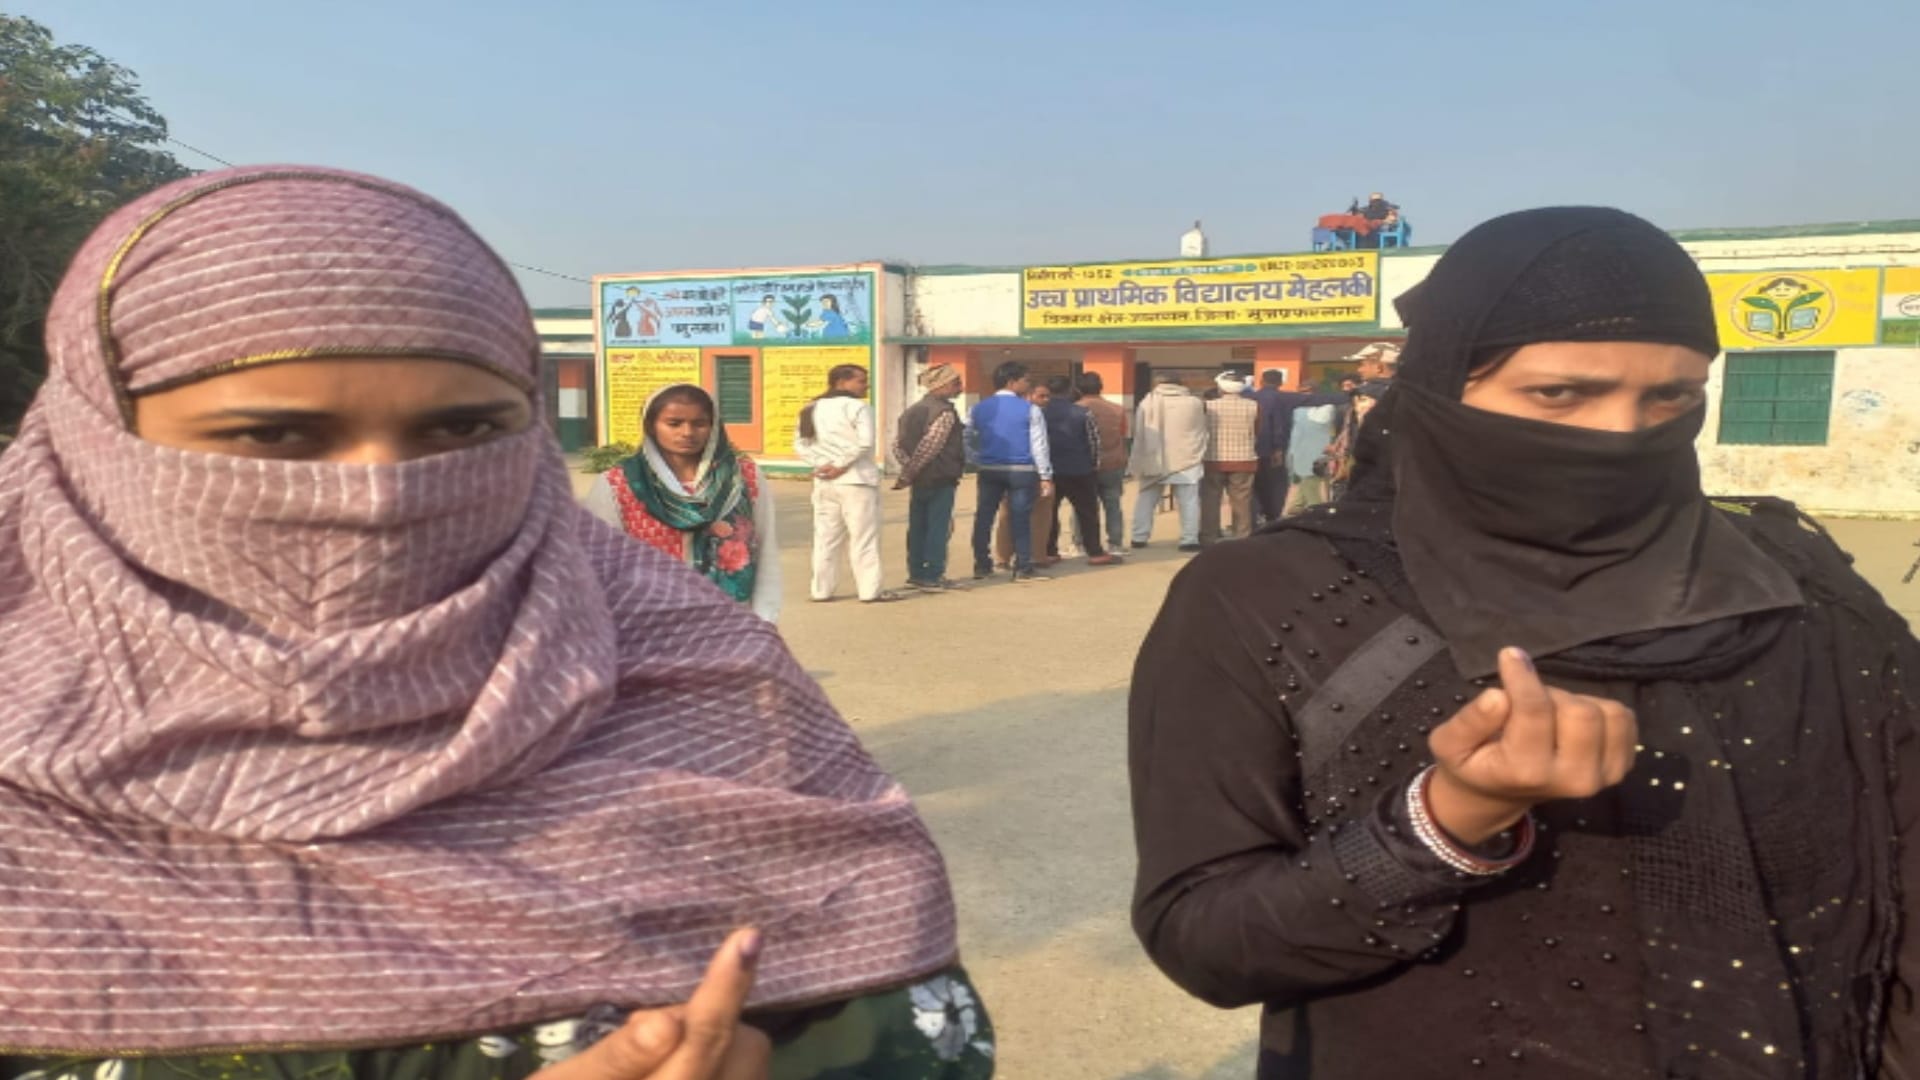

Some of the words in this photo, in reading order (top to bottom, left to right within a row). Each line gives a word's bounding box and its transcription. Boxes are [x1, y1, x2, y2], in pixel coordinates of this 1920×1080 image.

[1026, 288, 1068, 309] उच्च
[1073, 279, 1168, 308] प्राथमिक
[1172, 277, 1283, 304] विद्यालय
[1287, 271, 1374, 302] मेहलकी
